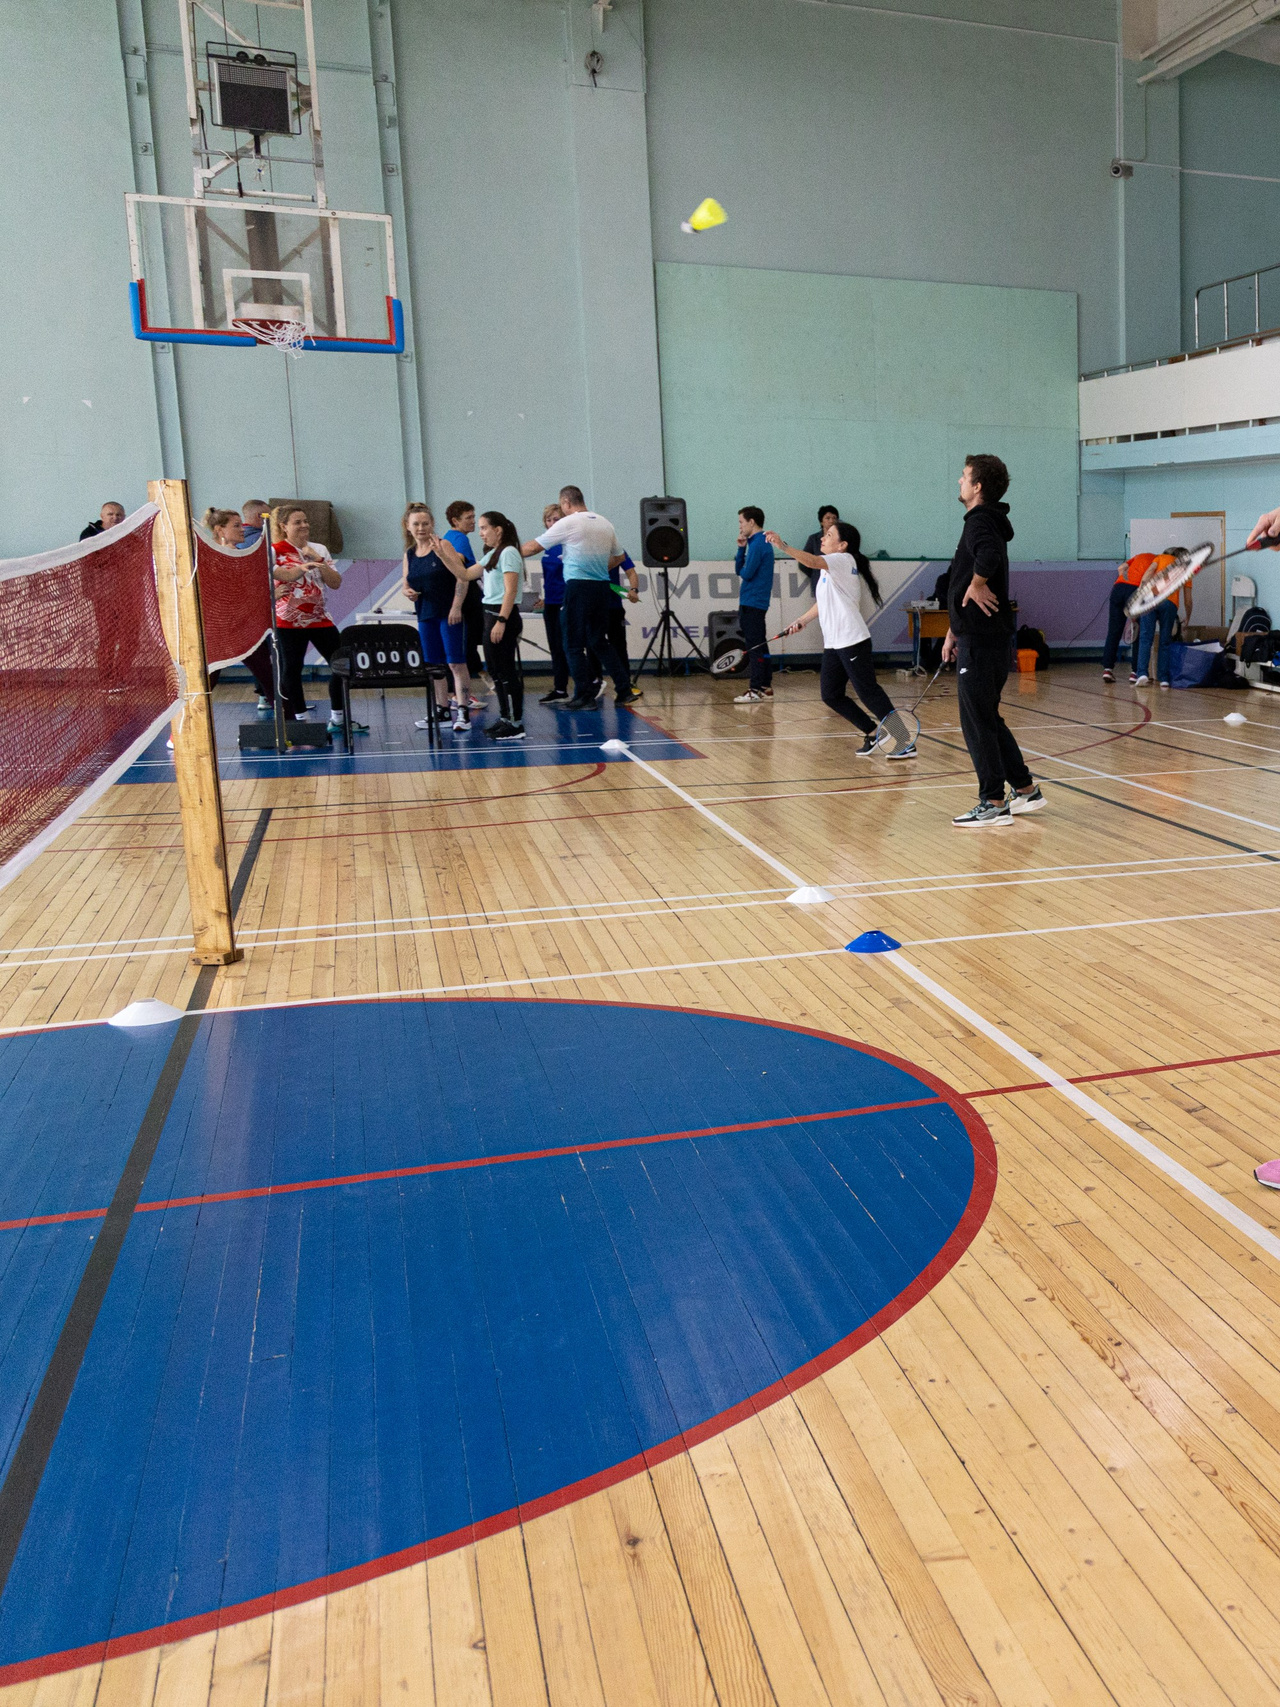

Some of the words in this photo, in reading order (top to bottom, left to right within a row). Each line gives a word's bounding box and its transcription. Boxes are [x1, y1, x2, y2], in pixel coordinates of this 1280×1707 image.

[357, 652, 370, 669] 0
[376, 651, 387, 663] 0
[390, 650, 400, 663] 0
[407, 650, 420, 667] 0
